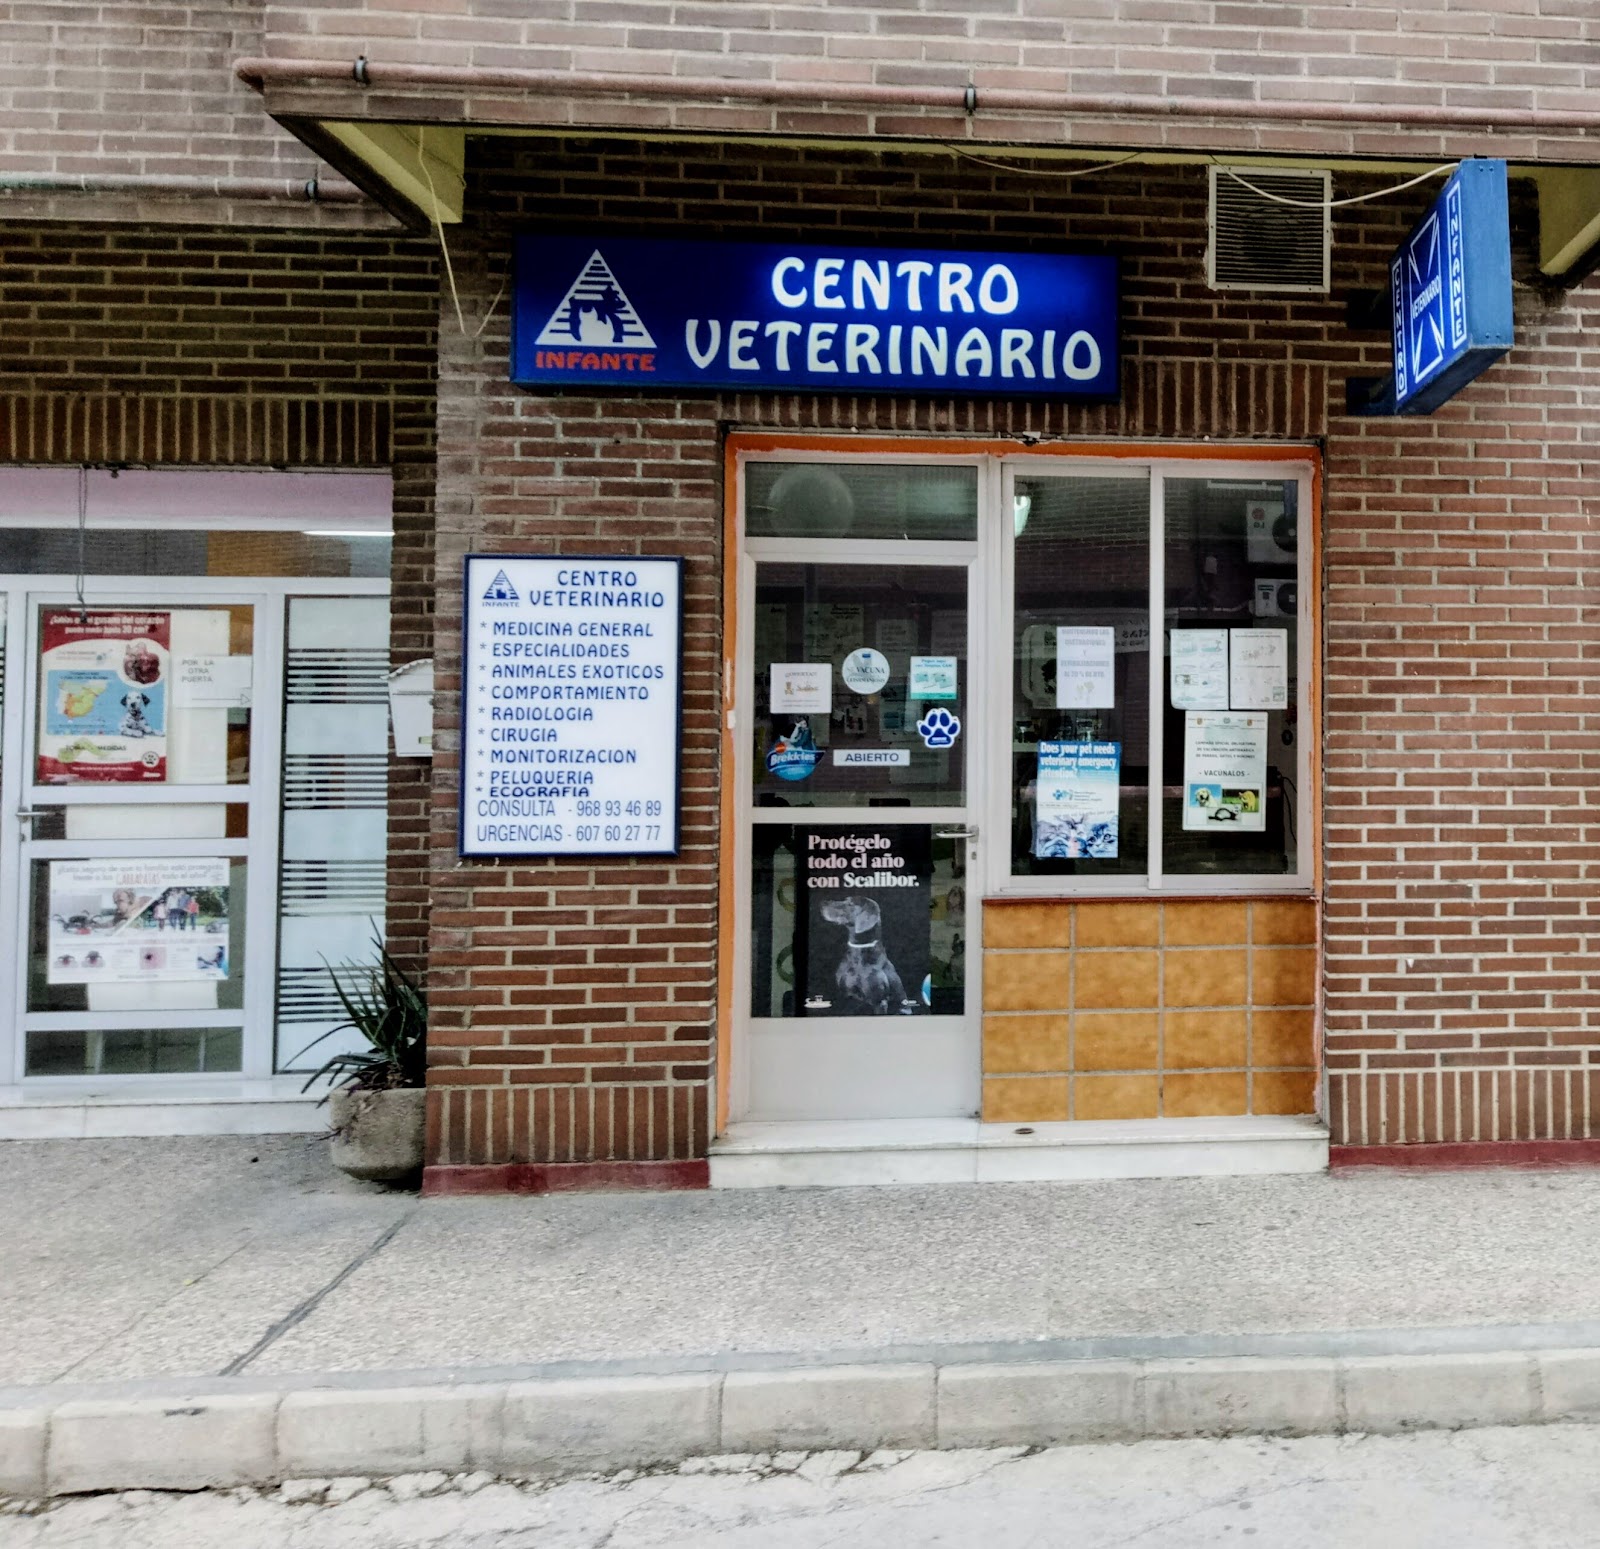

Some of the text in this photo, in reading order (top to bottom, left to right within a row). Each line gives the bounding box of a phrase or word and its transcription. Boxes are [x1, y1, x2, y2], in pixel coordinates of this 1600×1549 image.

[1450, 197, 1464, 337] INFANTE
[771, 257, 1018, 315] CENTRO
[1412, 274, 1440, 319] VETERINARIO
[1393, 268, 1405, 392] CENTRO
[685, 319, 1102, 381] VETERINARIO
[535, 351, 656, 372] INFANTE
[557, 570, 637, 587] CENTRO
[529, 590, 664, 608] VETERINARIO
[493, 621, 655, 638] MEDICINA GENERAL
[492, 643, 630, 658] ESPECIALIDADES
[182, 659, 198, 667] POR
[187, 668, 210, 676] OTRA
[492, 664, 664, 679] ANIMALES EXOTICOS
[181, 676, 214, 684] PUERTA
[491, 686, 649, 700] COMPORTAMIENTO
[491, 707, 594, 721] RADIOLOGIA
[490, 728, 557, 742] CIRUGIA
[491, 749, 637, 763] MONITORIZACION
[845, 753, 900, 762] ABIERTO
[1041, 742, 1115, 757] Does your pet needs
[770, 751, 816, 767] Brekkies
[1040, 756, 1117, 770] veterinary emergency
[490, 771, 594, 785] PELUQUERIA
[490, 786, 590, 797] ECOGRAFIA
[477, 800, 556, 817] CONSULTA
[576, 800, 601, 817] 968
[605, 800, 621, 817] 93
[625, 800, 641, 817] 46
[645, 800, 662, 816] 89
[477, 824, 563, 842] URGENCIAS
[576, 825, 601, 841] 607
[604, 825, 621, 841] 60
[625, 825, 641, 841] 27
[645, 825, 662, 841] 77
[807, 834, 891, 853] Protégelo
[807, 853, 905, 869] todo el año
[807, 872, 920, 888] con Scalibor.
